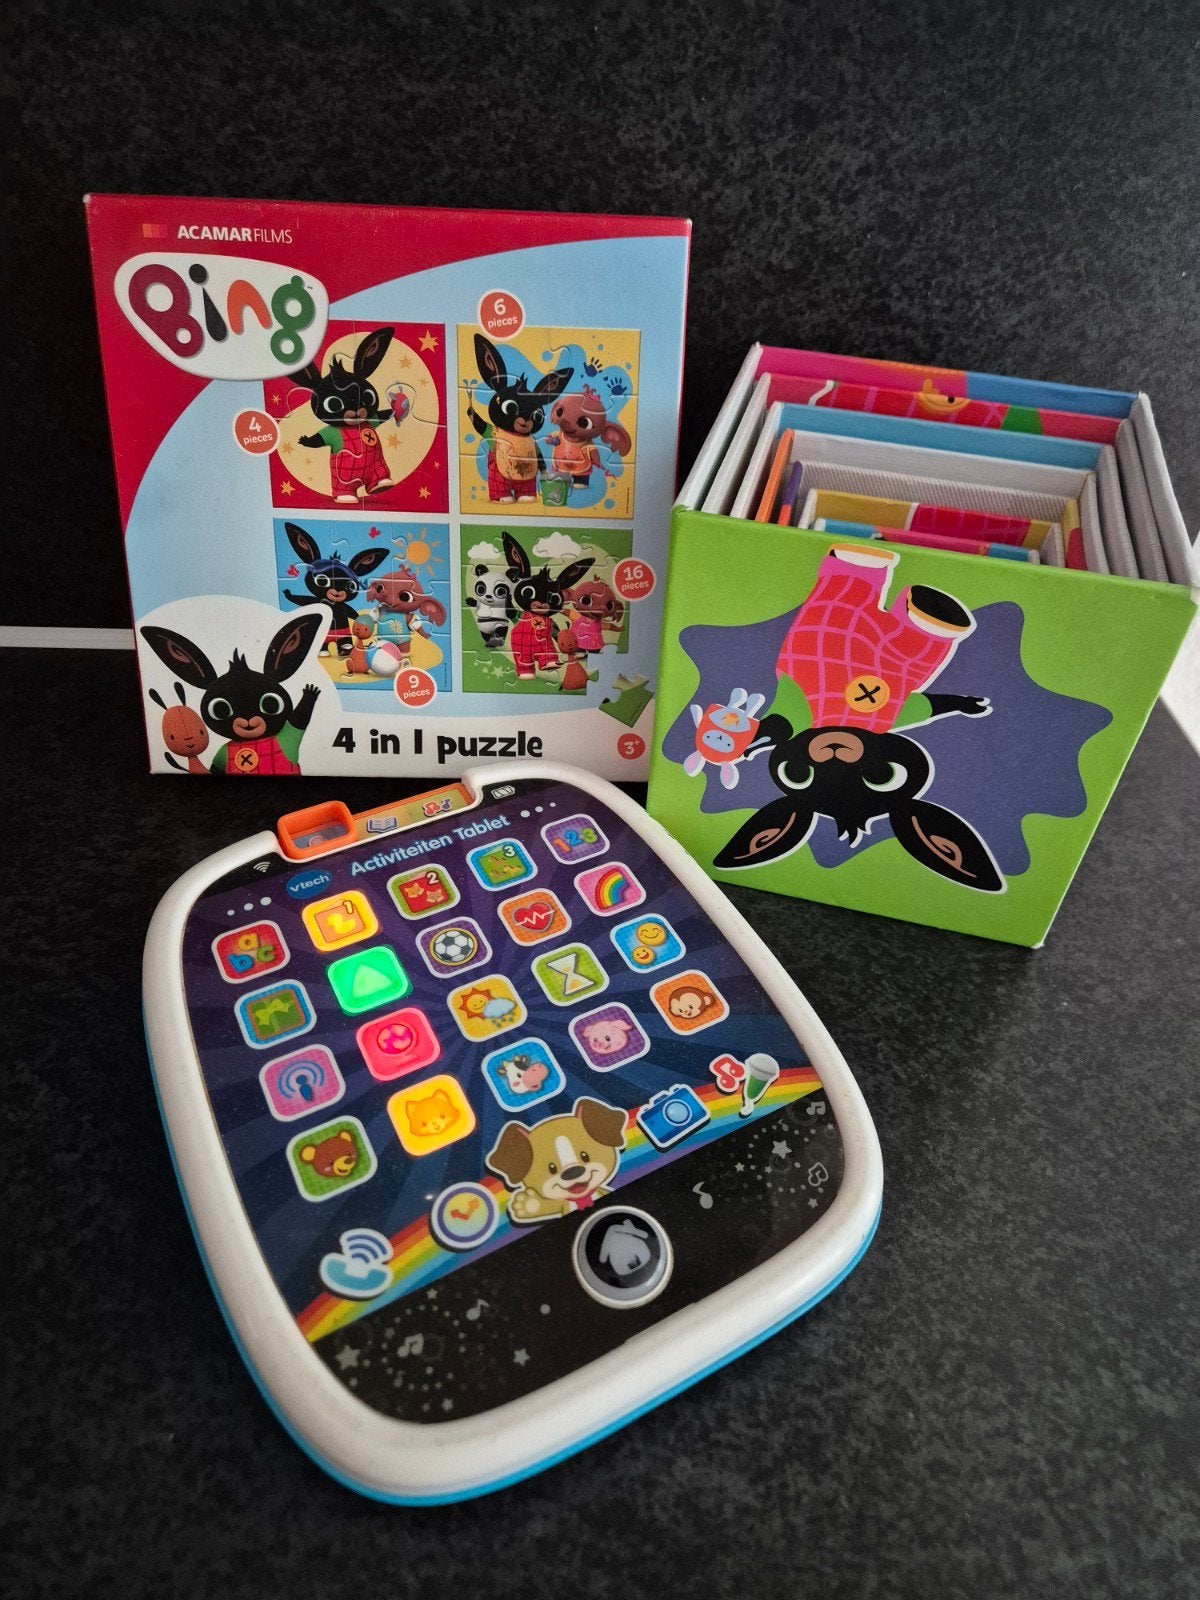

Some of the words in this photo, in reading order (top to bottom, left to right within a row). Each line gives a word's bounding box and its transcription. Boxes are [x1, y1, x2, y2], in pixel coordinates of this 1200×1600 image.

[493, 298, 507, 315] 6
[128, 264, 315, 365] Bing
[487, 315, 518, 329] pieces
[248, 416, 262, 433] 4
[243, 432, 273, 445] pieces
[623, 565, 644, 580] 16
[621, 579, 649, 592] pieces
[408, 674, 420, 689] 9
[403, 688, 431, 700] pieces
[332, 727, 356, 754] 4
[370, 728, 400, 754] in
[437, 730, 543, 764] puzzle
[351, 835, 453, 877] Activiteiten
[454, 814, 511, 841] Tablet
[505, 845, 517, 857] 3
[289, 875, 330, 893] vtech
[426, 872, 438, 884] 2
[343, 899, 354, 915] 1
